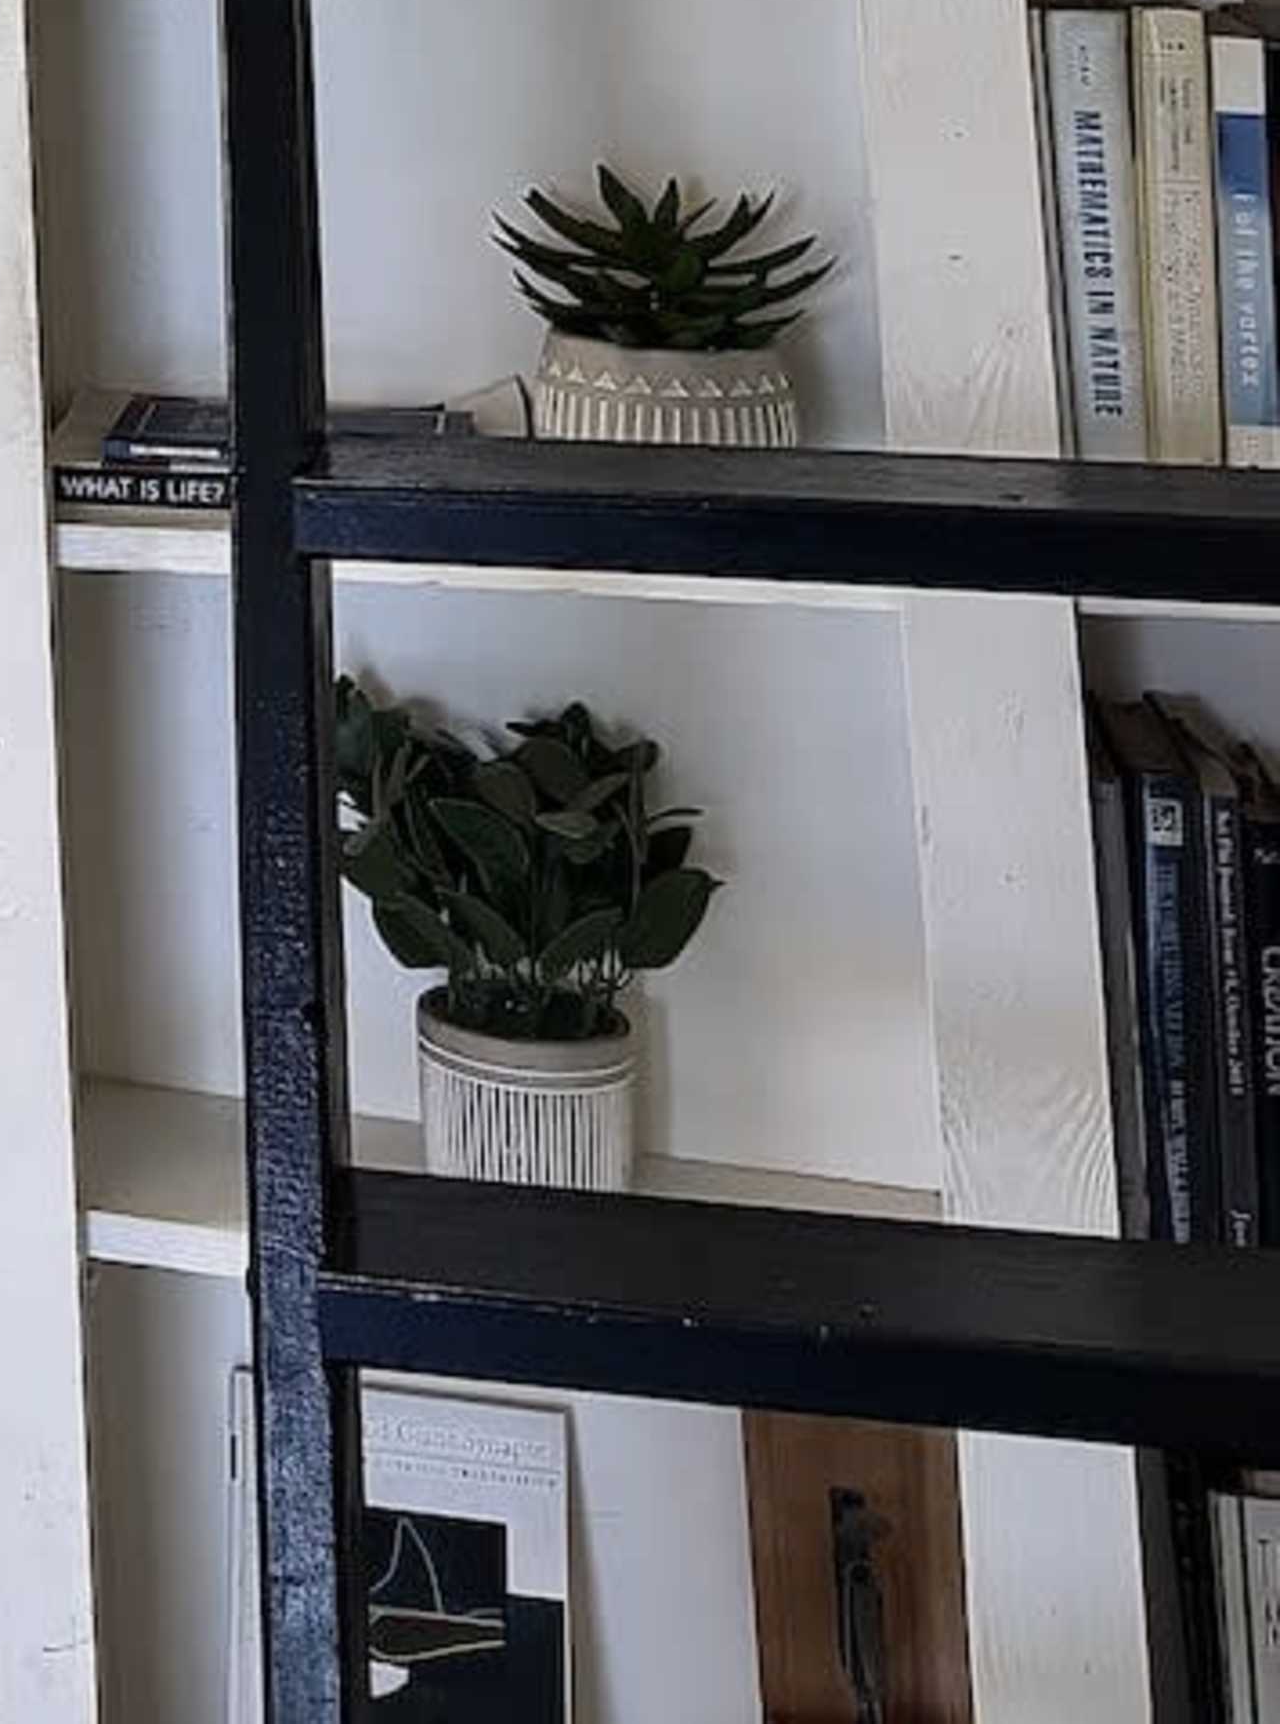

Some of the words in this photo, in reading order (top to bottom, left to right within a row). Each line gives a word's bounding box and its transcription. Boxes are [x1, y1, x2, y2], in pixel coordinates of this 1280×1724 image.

[1072, 110, 1114, 278] MATHEMATICS
[1088, 291, 1115, 315] IN
[1091, 325, 1124, 418] NATURE
[60, 475, 131, 498] WHAT
[140, 478, 160, 502] IS
[167, 479, 225, 504] LIFE?
